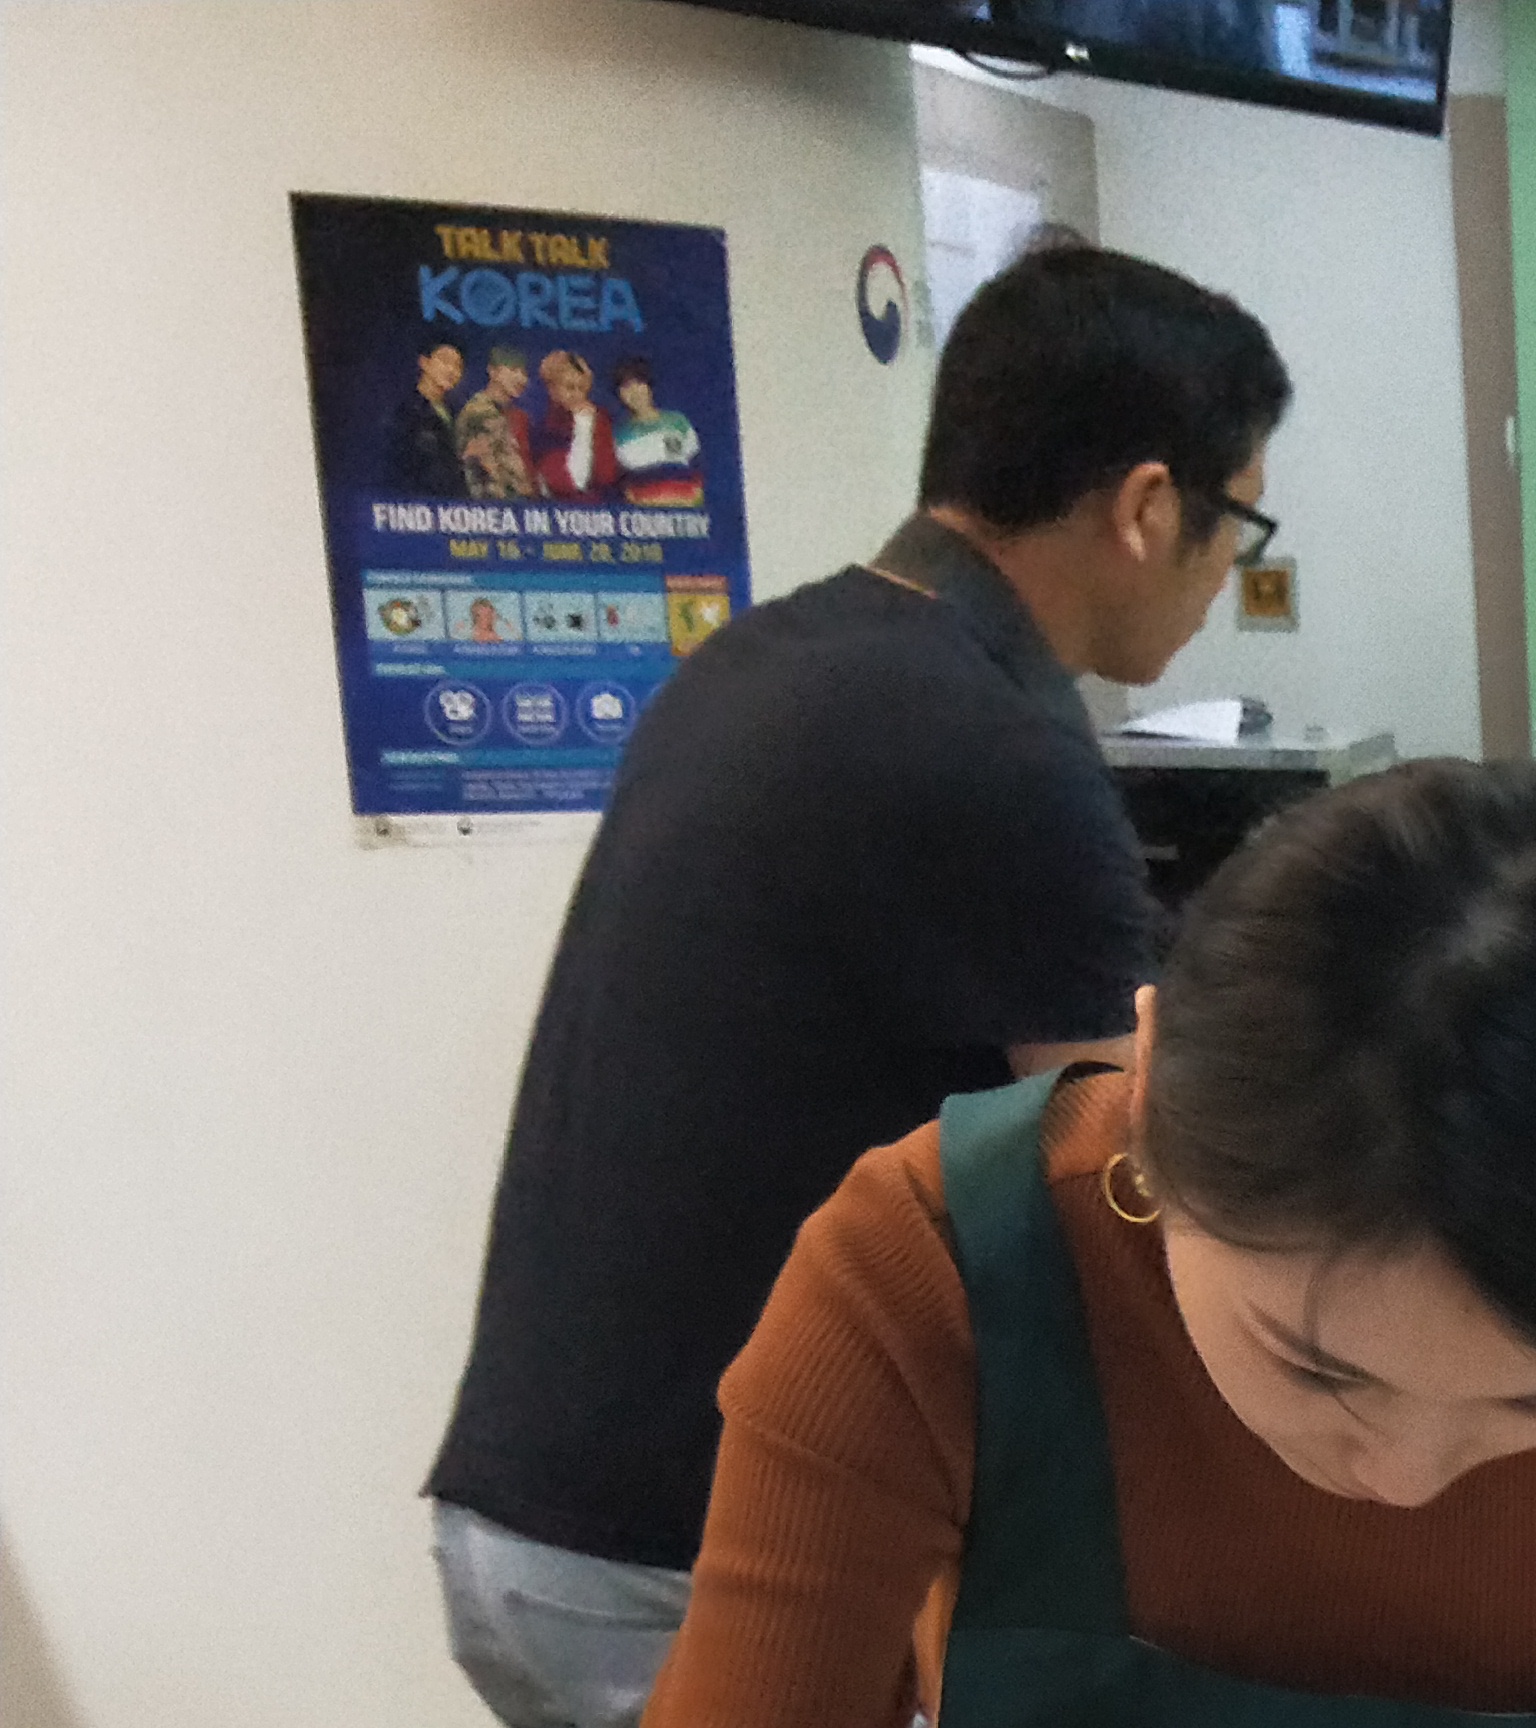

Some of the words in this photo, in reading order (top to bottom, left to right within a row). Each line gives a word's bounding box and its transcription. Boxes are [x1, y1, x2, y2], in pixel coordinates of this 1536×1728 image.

[435, 225, 524, 264] TALK
[529, 233, 610, 269] TALK
[418, 264, 644, 334] KOREA
[372, 503, 433, 534] FIND
[437, 504, 520, 535] KOREA
[523, 508, 551, 534] IN
[553, 509, 615, 537] YOUR
[618, 511, 711, 540] COUNTRY
